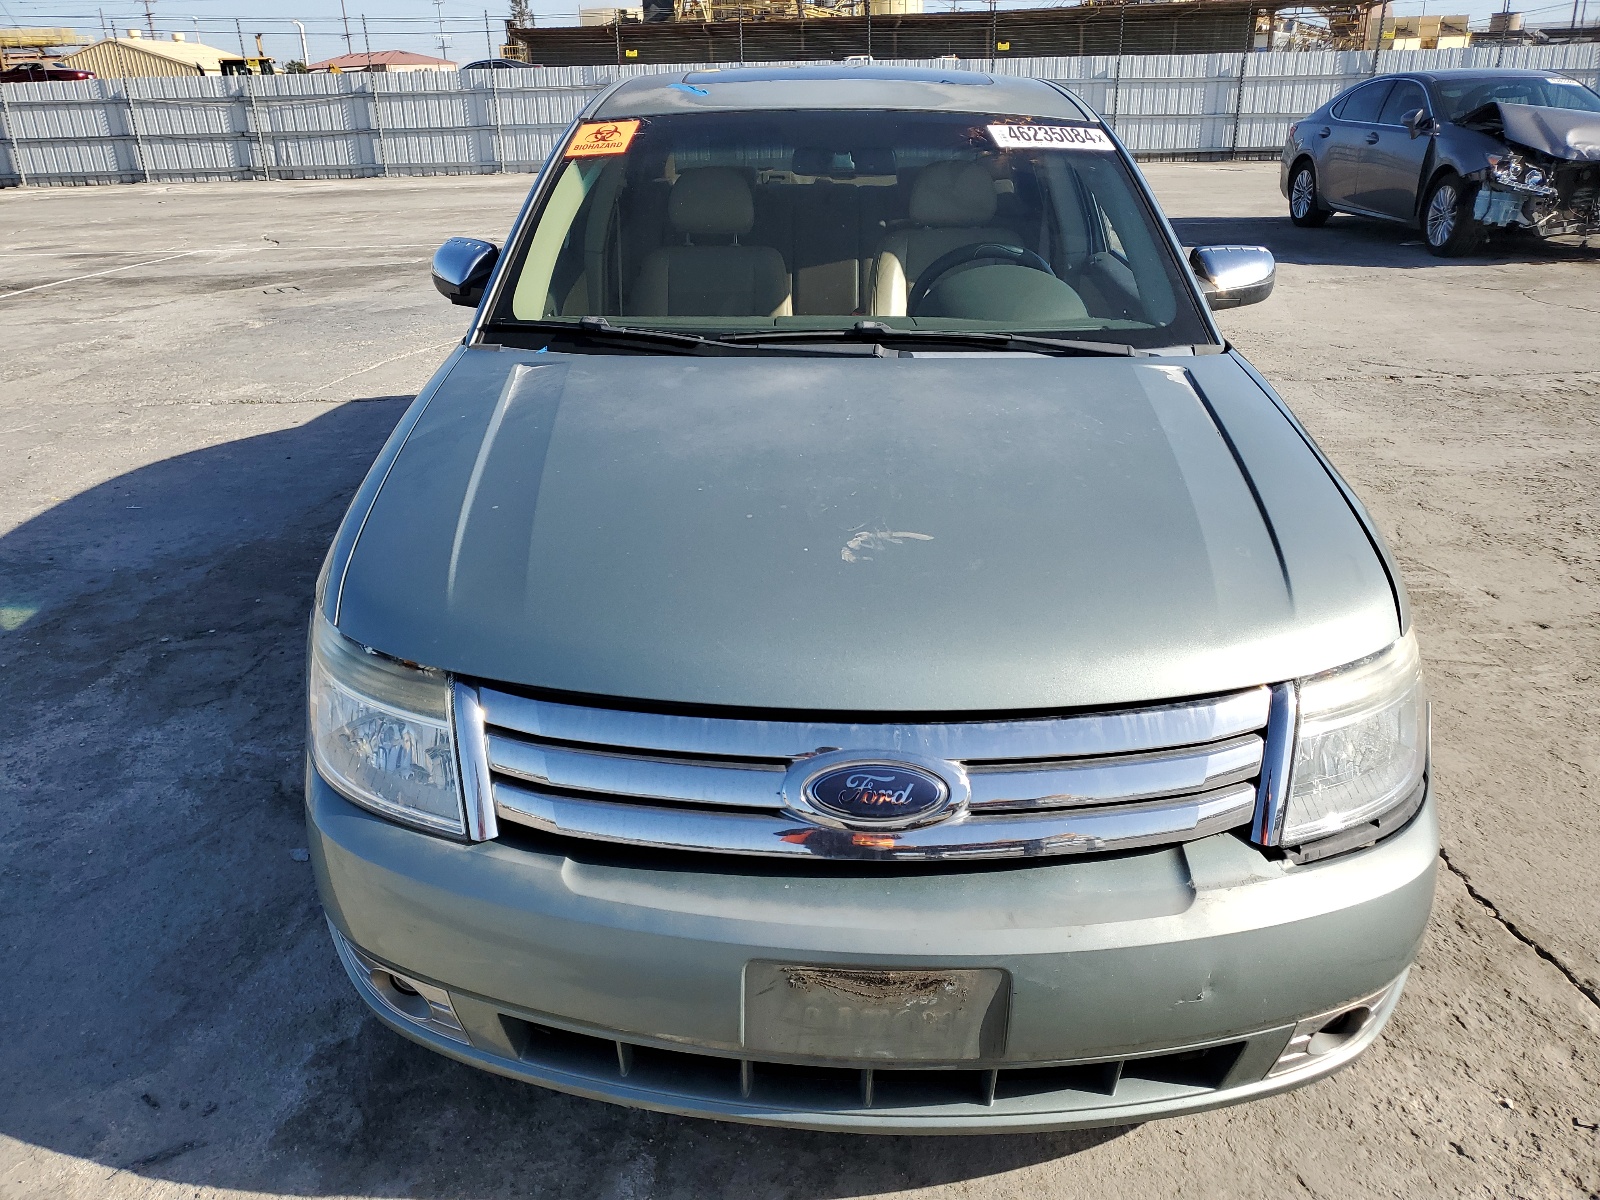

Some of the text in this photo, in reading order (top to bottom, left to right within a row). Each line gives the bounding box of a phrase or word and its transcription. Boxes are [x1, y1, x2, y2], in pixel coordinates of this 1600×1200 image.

[1008, 126, 1096, 144] 46235084
[573, 141, 623, 151] BIOHAZARD
[838, 774, 914, 805] Ford
